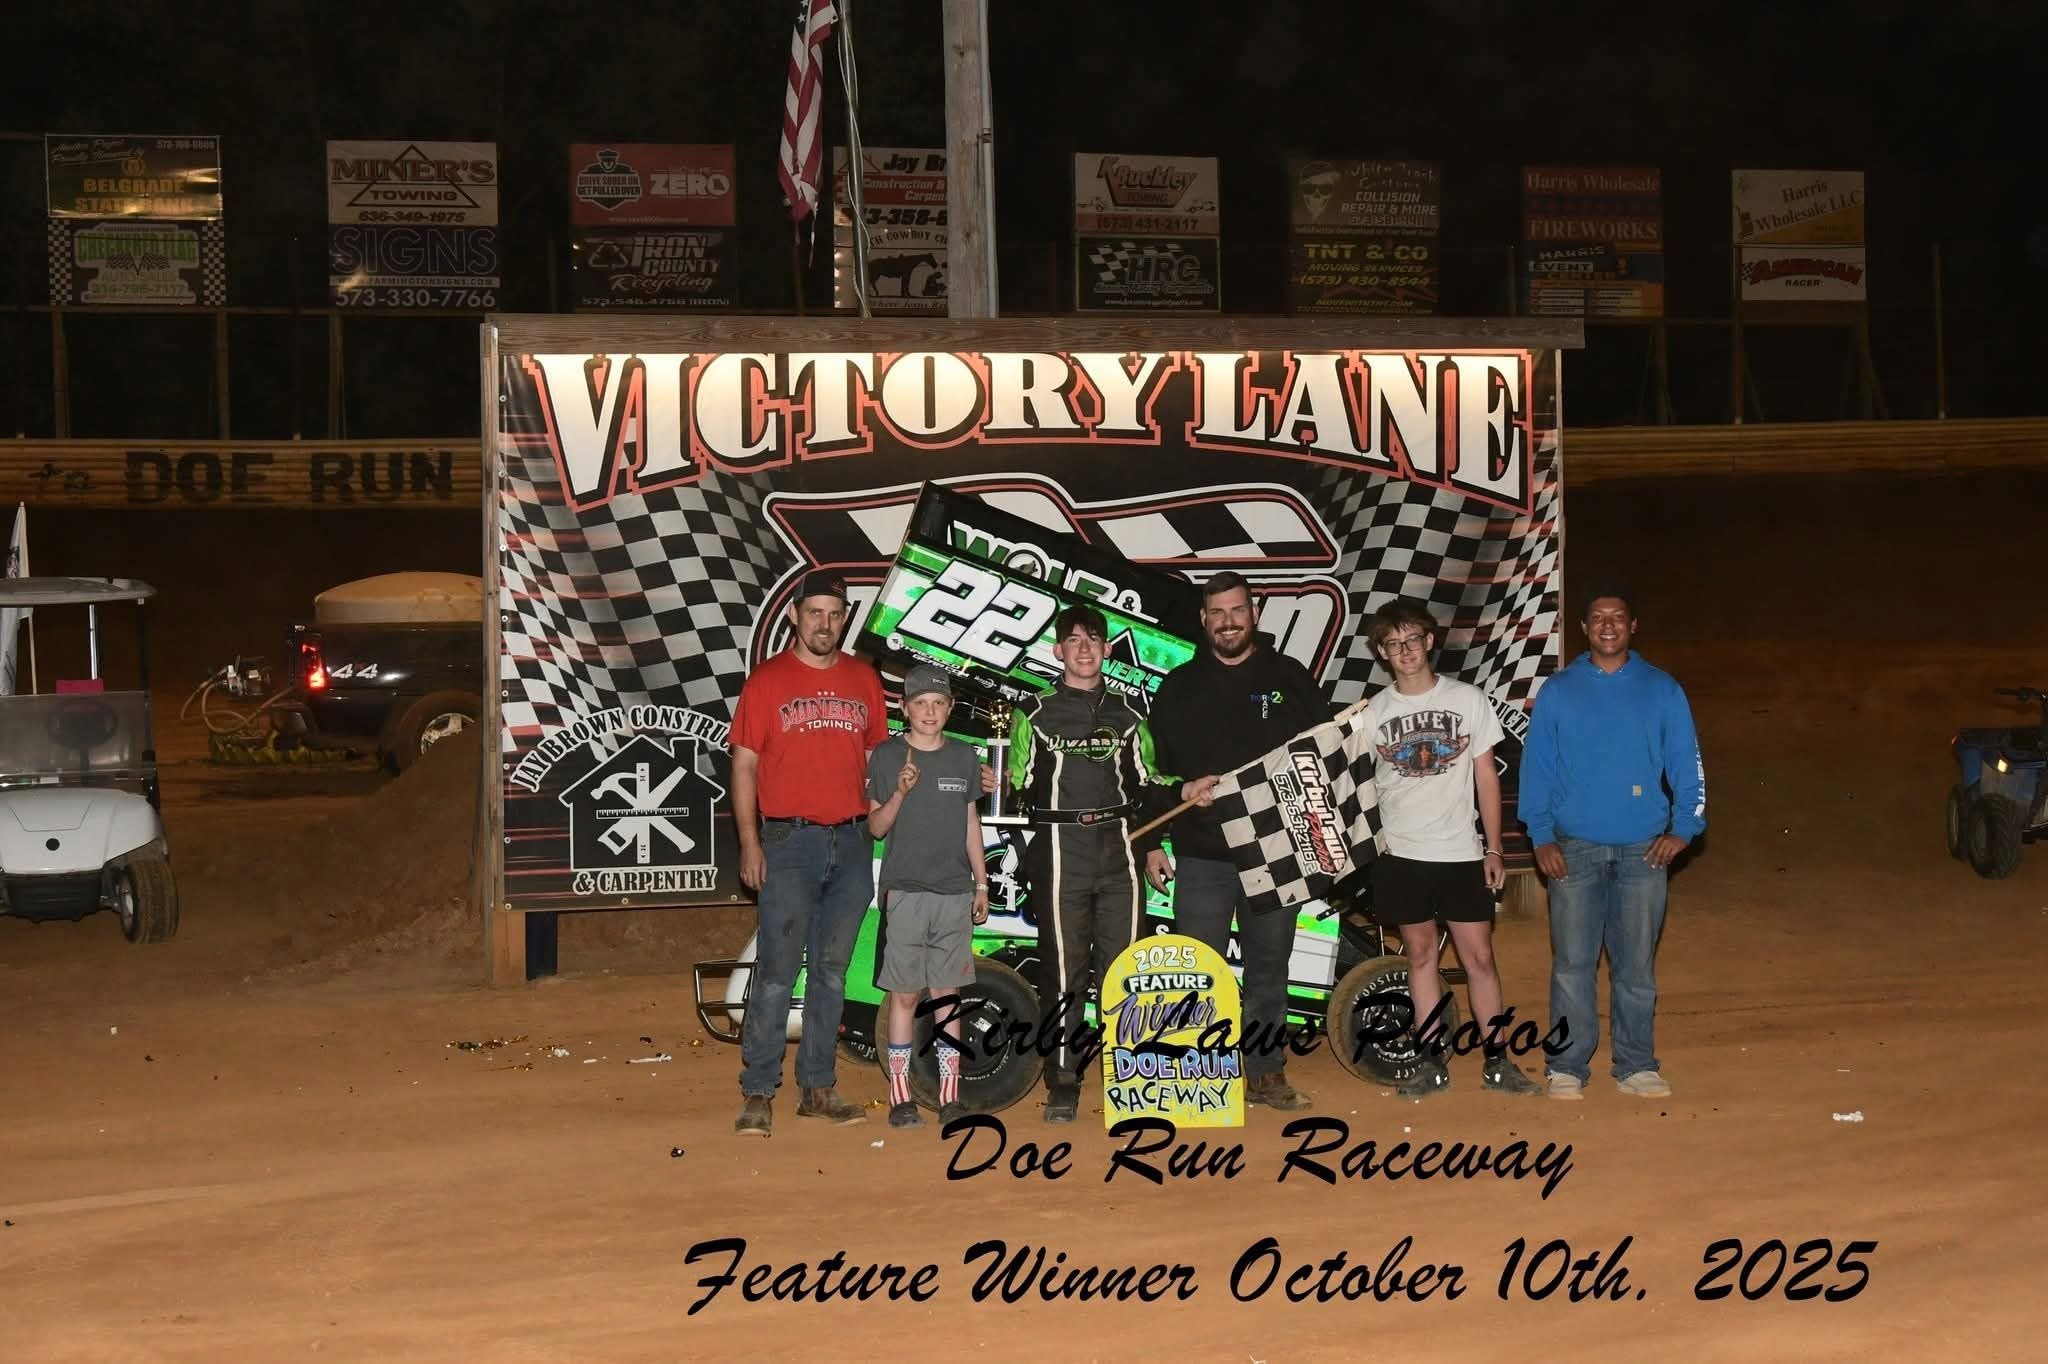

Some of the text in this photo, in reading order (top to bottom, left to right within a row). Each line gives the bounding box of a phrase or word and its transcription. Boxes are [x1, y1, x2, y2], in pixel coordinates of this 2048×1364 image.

[330, 158, 496, 183] MINER'S
[884, 153, 919, 173] Jay
[650, 174, 730, 196] ZERO
[1528, 172, 1659, 192] Harris Wholesale
[1782, 181, 1827, 201] Harris
[369, 190, 458, 201] TOWING
[1355, 192, 1421, 203] COLLISION
[1341, 202, 1385, 215] REPAIR
[1400, 203, 1438, 216] MORE
[1753, 200, 1825, 232] Wholesale
[886, 230, 931, 241] COWBOY
[1529, 218, 1657, 240] FIREWORKS
[334, 227, 497, 274] SIGNS
[631, 235, 706, 267] IRON
[1304, 243, 1429, 261] TNT & CO
[643, 258, 720, 277] COUNTY
[608, 272, 713, 293] Recycling
[1784, 279, 1820, 287] RACER
[335, 289, 496, 307] 573-330-7766
[528, 352, 1528, 509] VICTORY LANE
[125, 451, 274, 503] DOE
[308, 450, 454, 503] RUN
[896, 558, 1061, 672] 22
[806, 719, 853, 731] TOWING
[1380, 710, 1463, 749] LOYET
[511, 737, 553, 793] JAY
[546, 706, 627, 759] BROWN
[572, 866, 718, 894] & CARPENTRY
[1132, 945, 1198, 972] 2025
[1128, 974, 1209, 993] FEATURE
[1114, 1047, 1242, 1082] DOE RUN
[1106, 1080, 1233, 1113] RACEWAY
